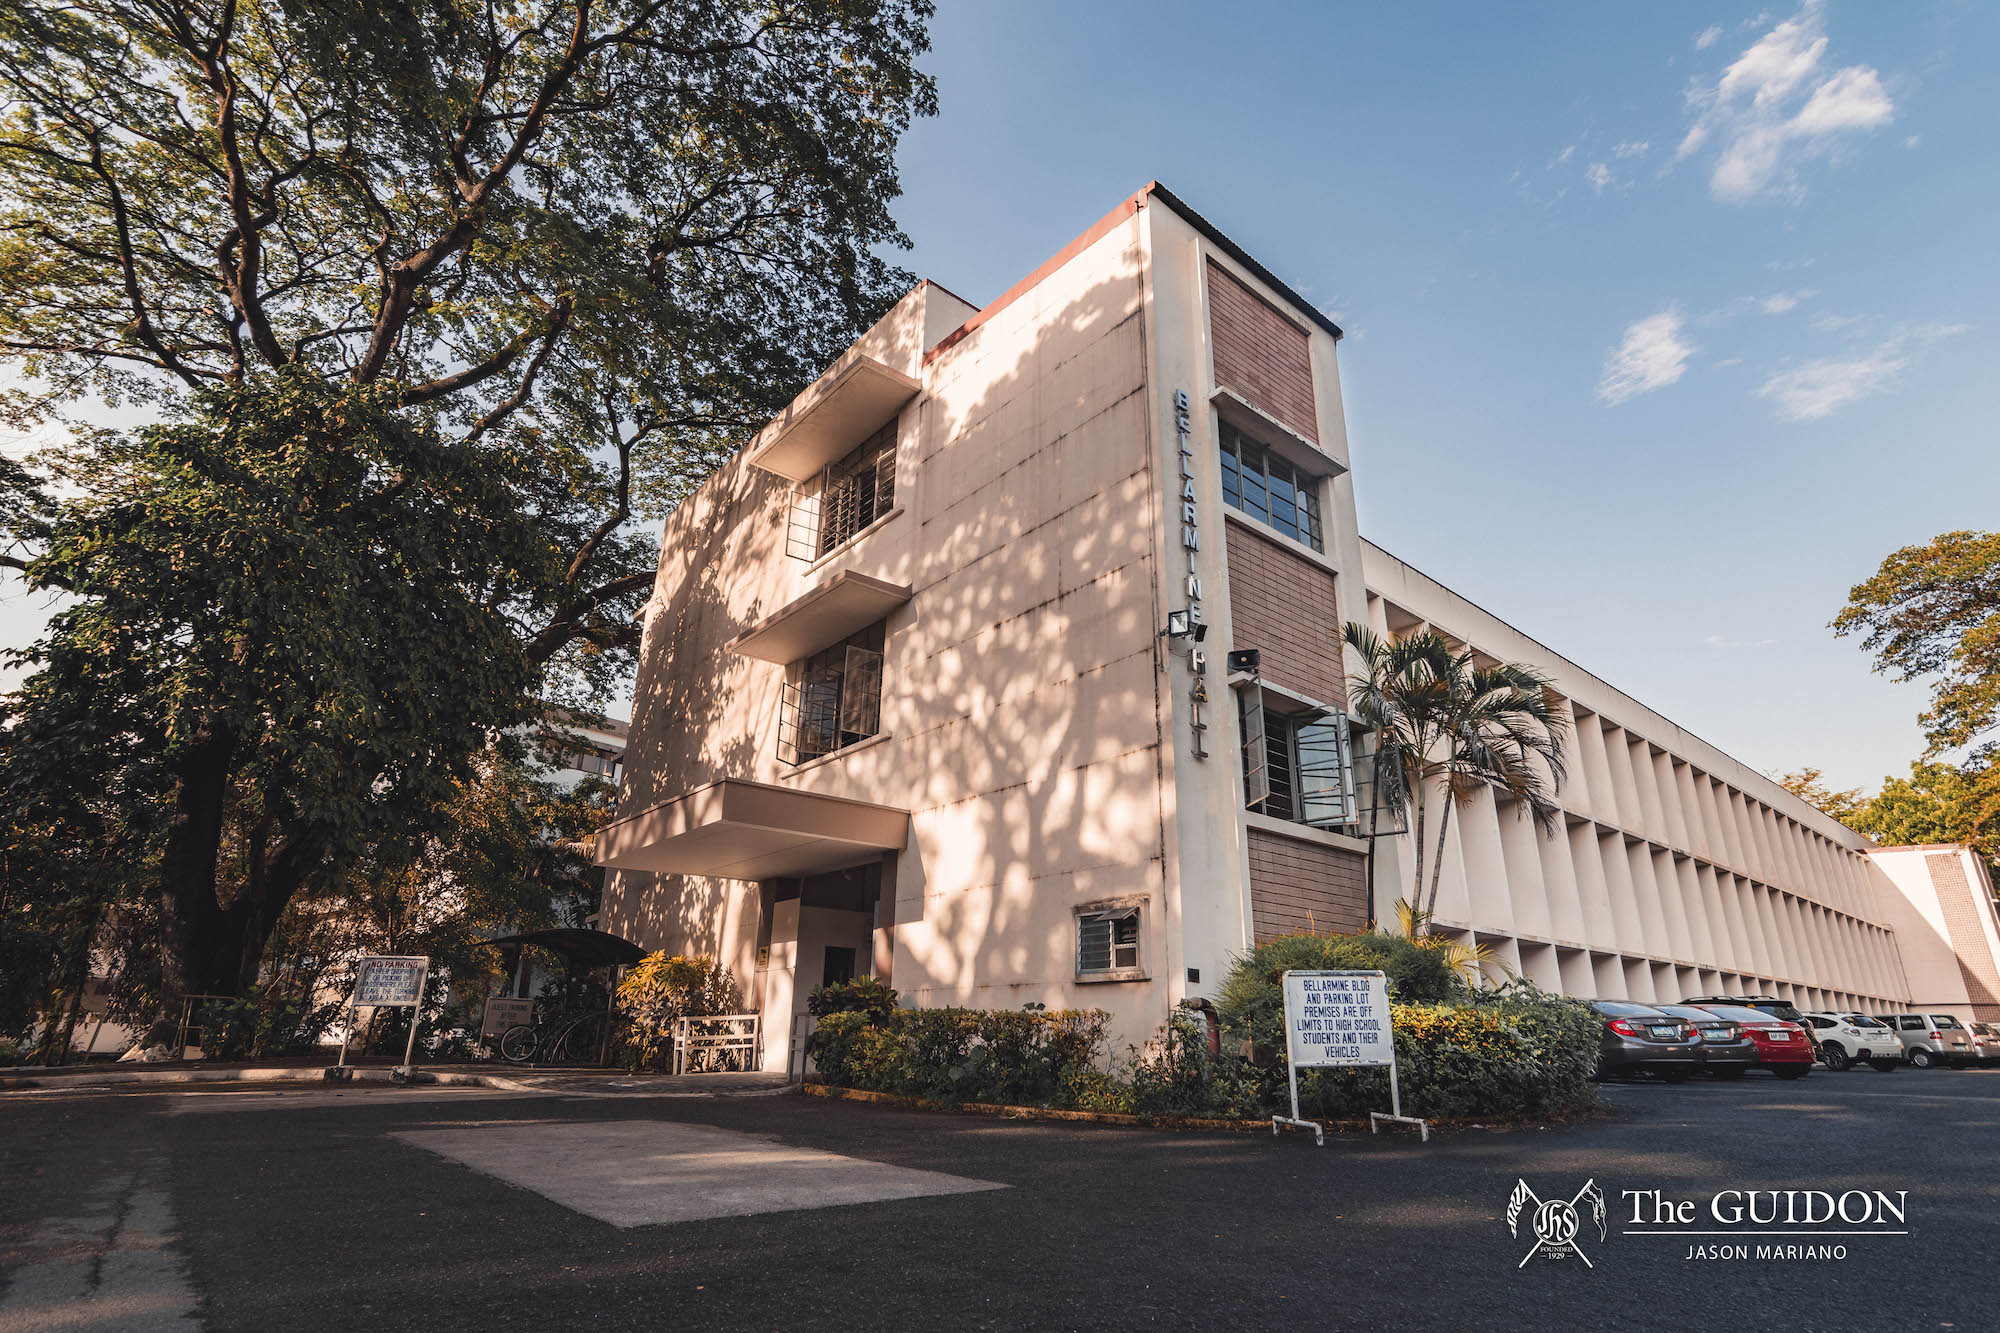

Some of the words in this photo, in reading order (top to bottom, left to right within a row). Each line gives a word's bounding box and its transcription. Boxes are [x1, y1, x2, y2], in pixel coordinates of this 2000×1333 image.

[1175, 388, 1201, 625] BELLARMINE
[1186, 646, 1209, 761] HALL
[385, 961, 418, 969] PARKING
[1303, 980, 1349, 991] BELLARMINE
[1306, 993, 1321, 1004] AND
[1324, 993, 1353, 1004] PARKING
[1356, 993, 1369, 1004] LOT
[1304, 1006, 1340, 1017] PREMISES
[1343, 1006, 1357, 1017] ARE
[1360, 1006, 1372, 1017] OFF
[1297, 1019, 1322, 1031] LIMITS
[1324, 1019, 1333, 1030] TO
[1336, 1019, 1352, 1030] HIGH
[1355, 1019, 1381, 1031] SCHOOL
[1303, 1032, 1340, 1044] STUDENTS
[1342, 1032, 1357, 1044] AND
[1358, 1032, 1379, 1044] THEIR
[1325, 1046, 1360, 1058] VEHICLES
